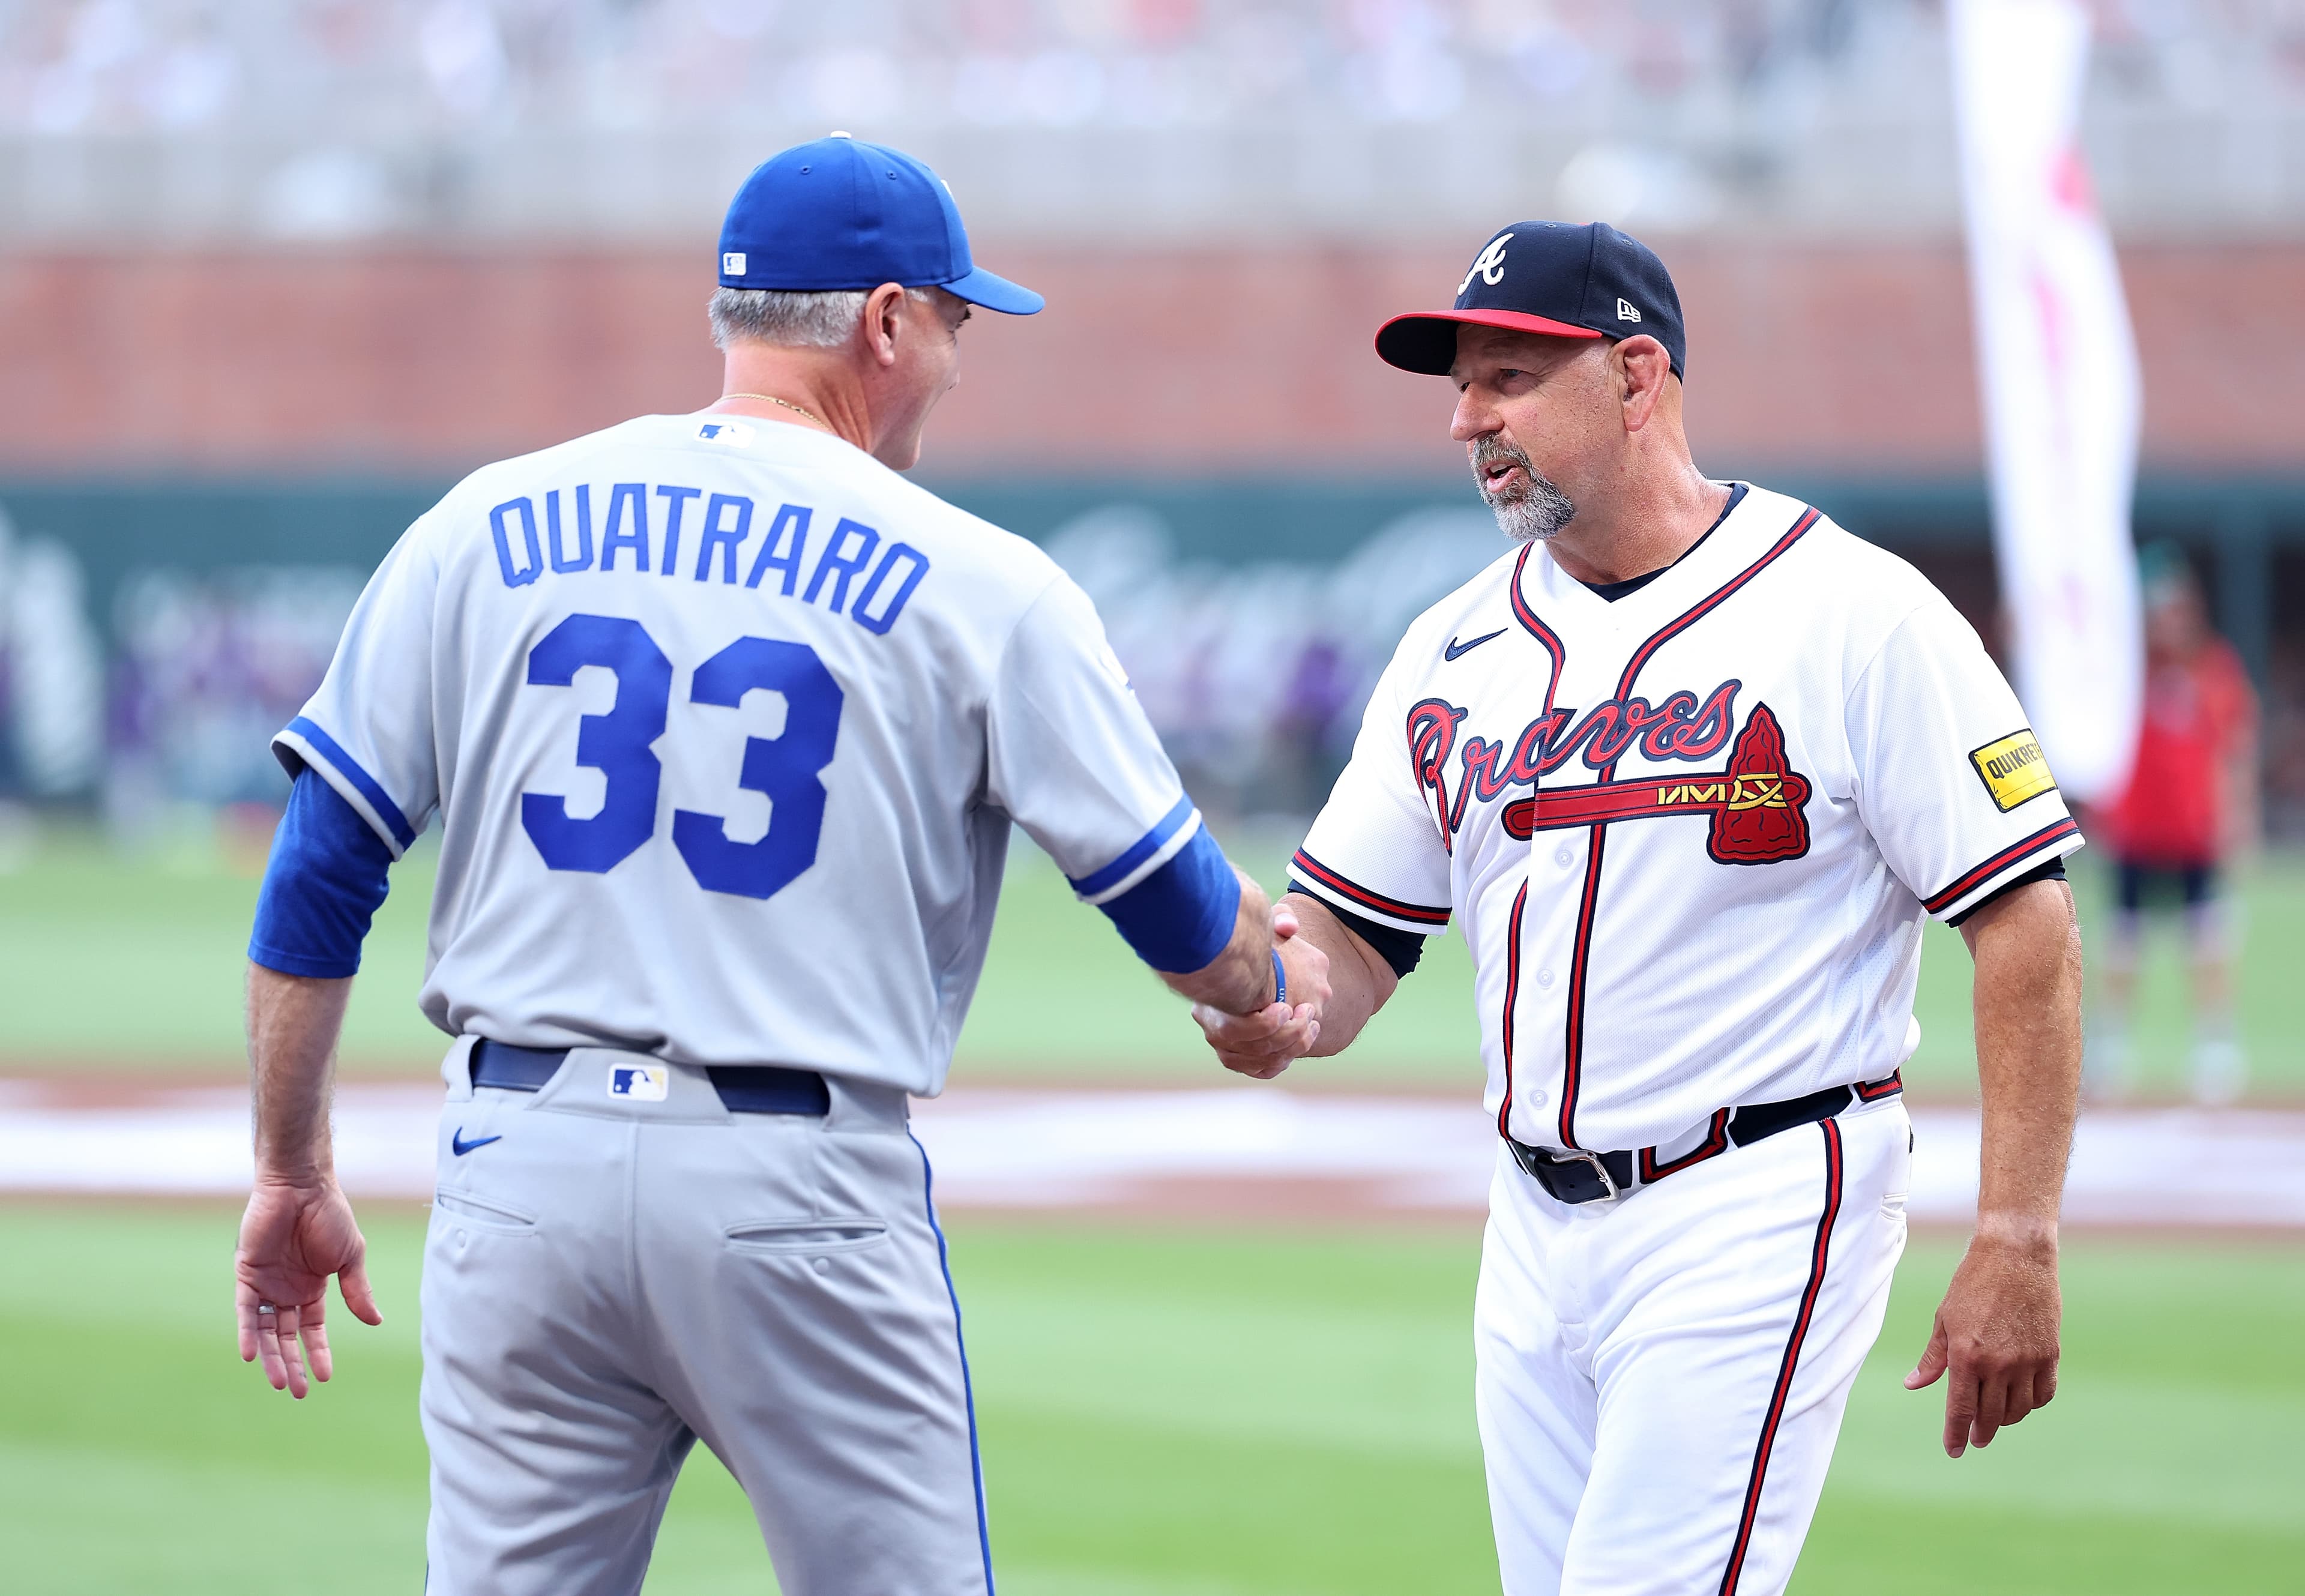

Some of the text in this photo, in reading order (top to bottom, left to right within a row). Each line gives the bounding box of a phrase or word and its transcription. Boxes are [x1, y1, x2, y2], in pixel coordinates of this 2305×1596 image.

[1457, 232, 1514, 296] A
[489, 483, 930, 636] QUATRARO
[521, 613, 844, 900] 33
[1407, 679, 1741, 857] Braves
